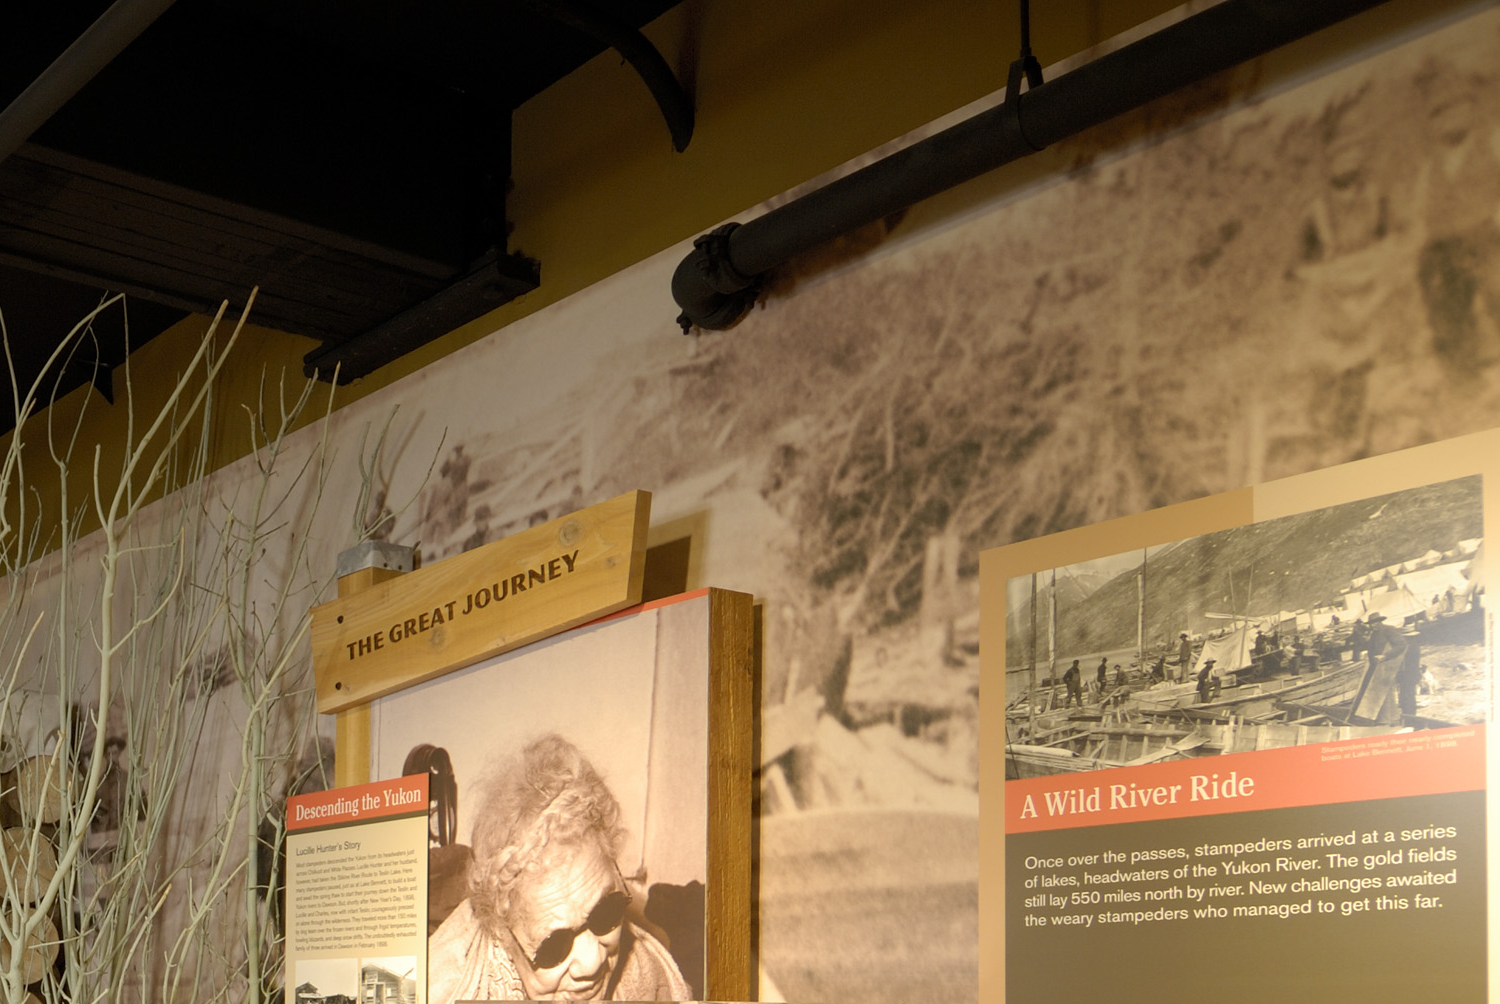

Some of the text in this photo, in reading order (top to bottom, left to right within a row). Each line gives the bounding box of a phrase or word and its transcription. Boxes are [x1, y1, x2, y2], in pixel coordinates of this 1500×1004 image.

[347, 550, 579, 660] THE GREAT JOURNEY
[296, 788, 421, 821] Descending the Yukon
[1020, 772, 1255, 819] A Wild River Ride
[296, 840, 361, 856] Lucille Hunter's Story
[1025, 824, 1457, 870] Once over the passes, stampeders arrived at a series
[1025, 846, 1457, 888] of lakes, headwaters of the Yukon River. The gold fields
[1025, 869, 1457, 909] still lay 550 miles north by river. New challenges awaited
[1025, 894, 1443, 928] the weary stampeders who managed to get this far.
